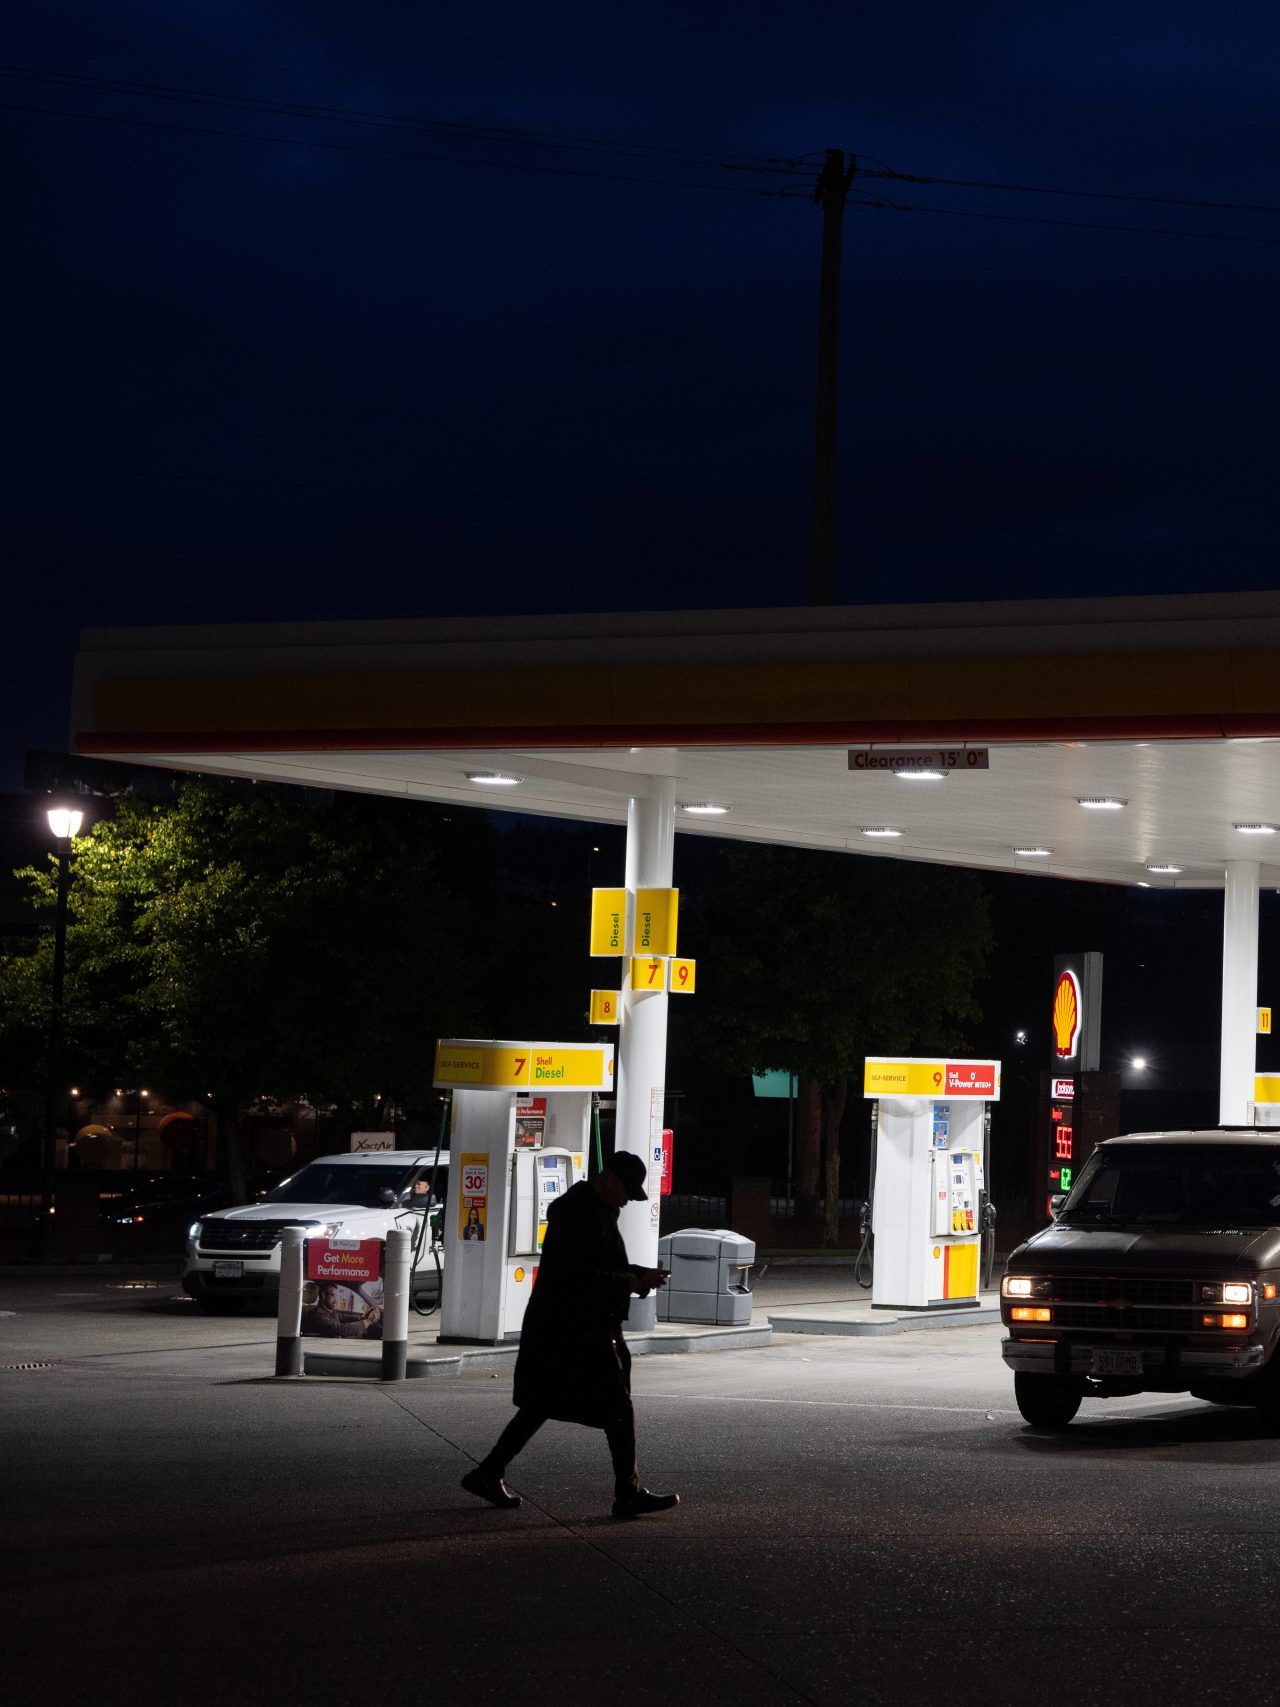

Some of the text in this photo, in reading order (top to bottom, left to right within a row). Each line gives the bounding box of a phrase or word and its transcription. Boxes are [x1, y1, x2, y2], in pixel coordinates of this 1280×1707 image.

[854, 752, 933, 768] Clearance
[940, 751, 960, 767] 15'
[610, 913, 620, 947] Diesel
[642, 912, 651, 947] Diesel
[648, 964, 658, 984] 7
[678, 966, 688, 986] 9
[604, 1002, 610, 1013] 8
[1262, 1013, 1268, 1028] 11
[514, 1058, 526, 1076] 7
[536, 1056, 552, 1066] Shell
[536, 1066, 564, 1078] Diesel
[932, 1072, 942, 1087] 9
[949, 1079, 974, 1088] V-Power
[354, 1138, 393, 1152] XactAir
[324, 1252, 364, 1264] Get More
[317, 1264, 370, 1277] Performance
